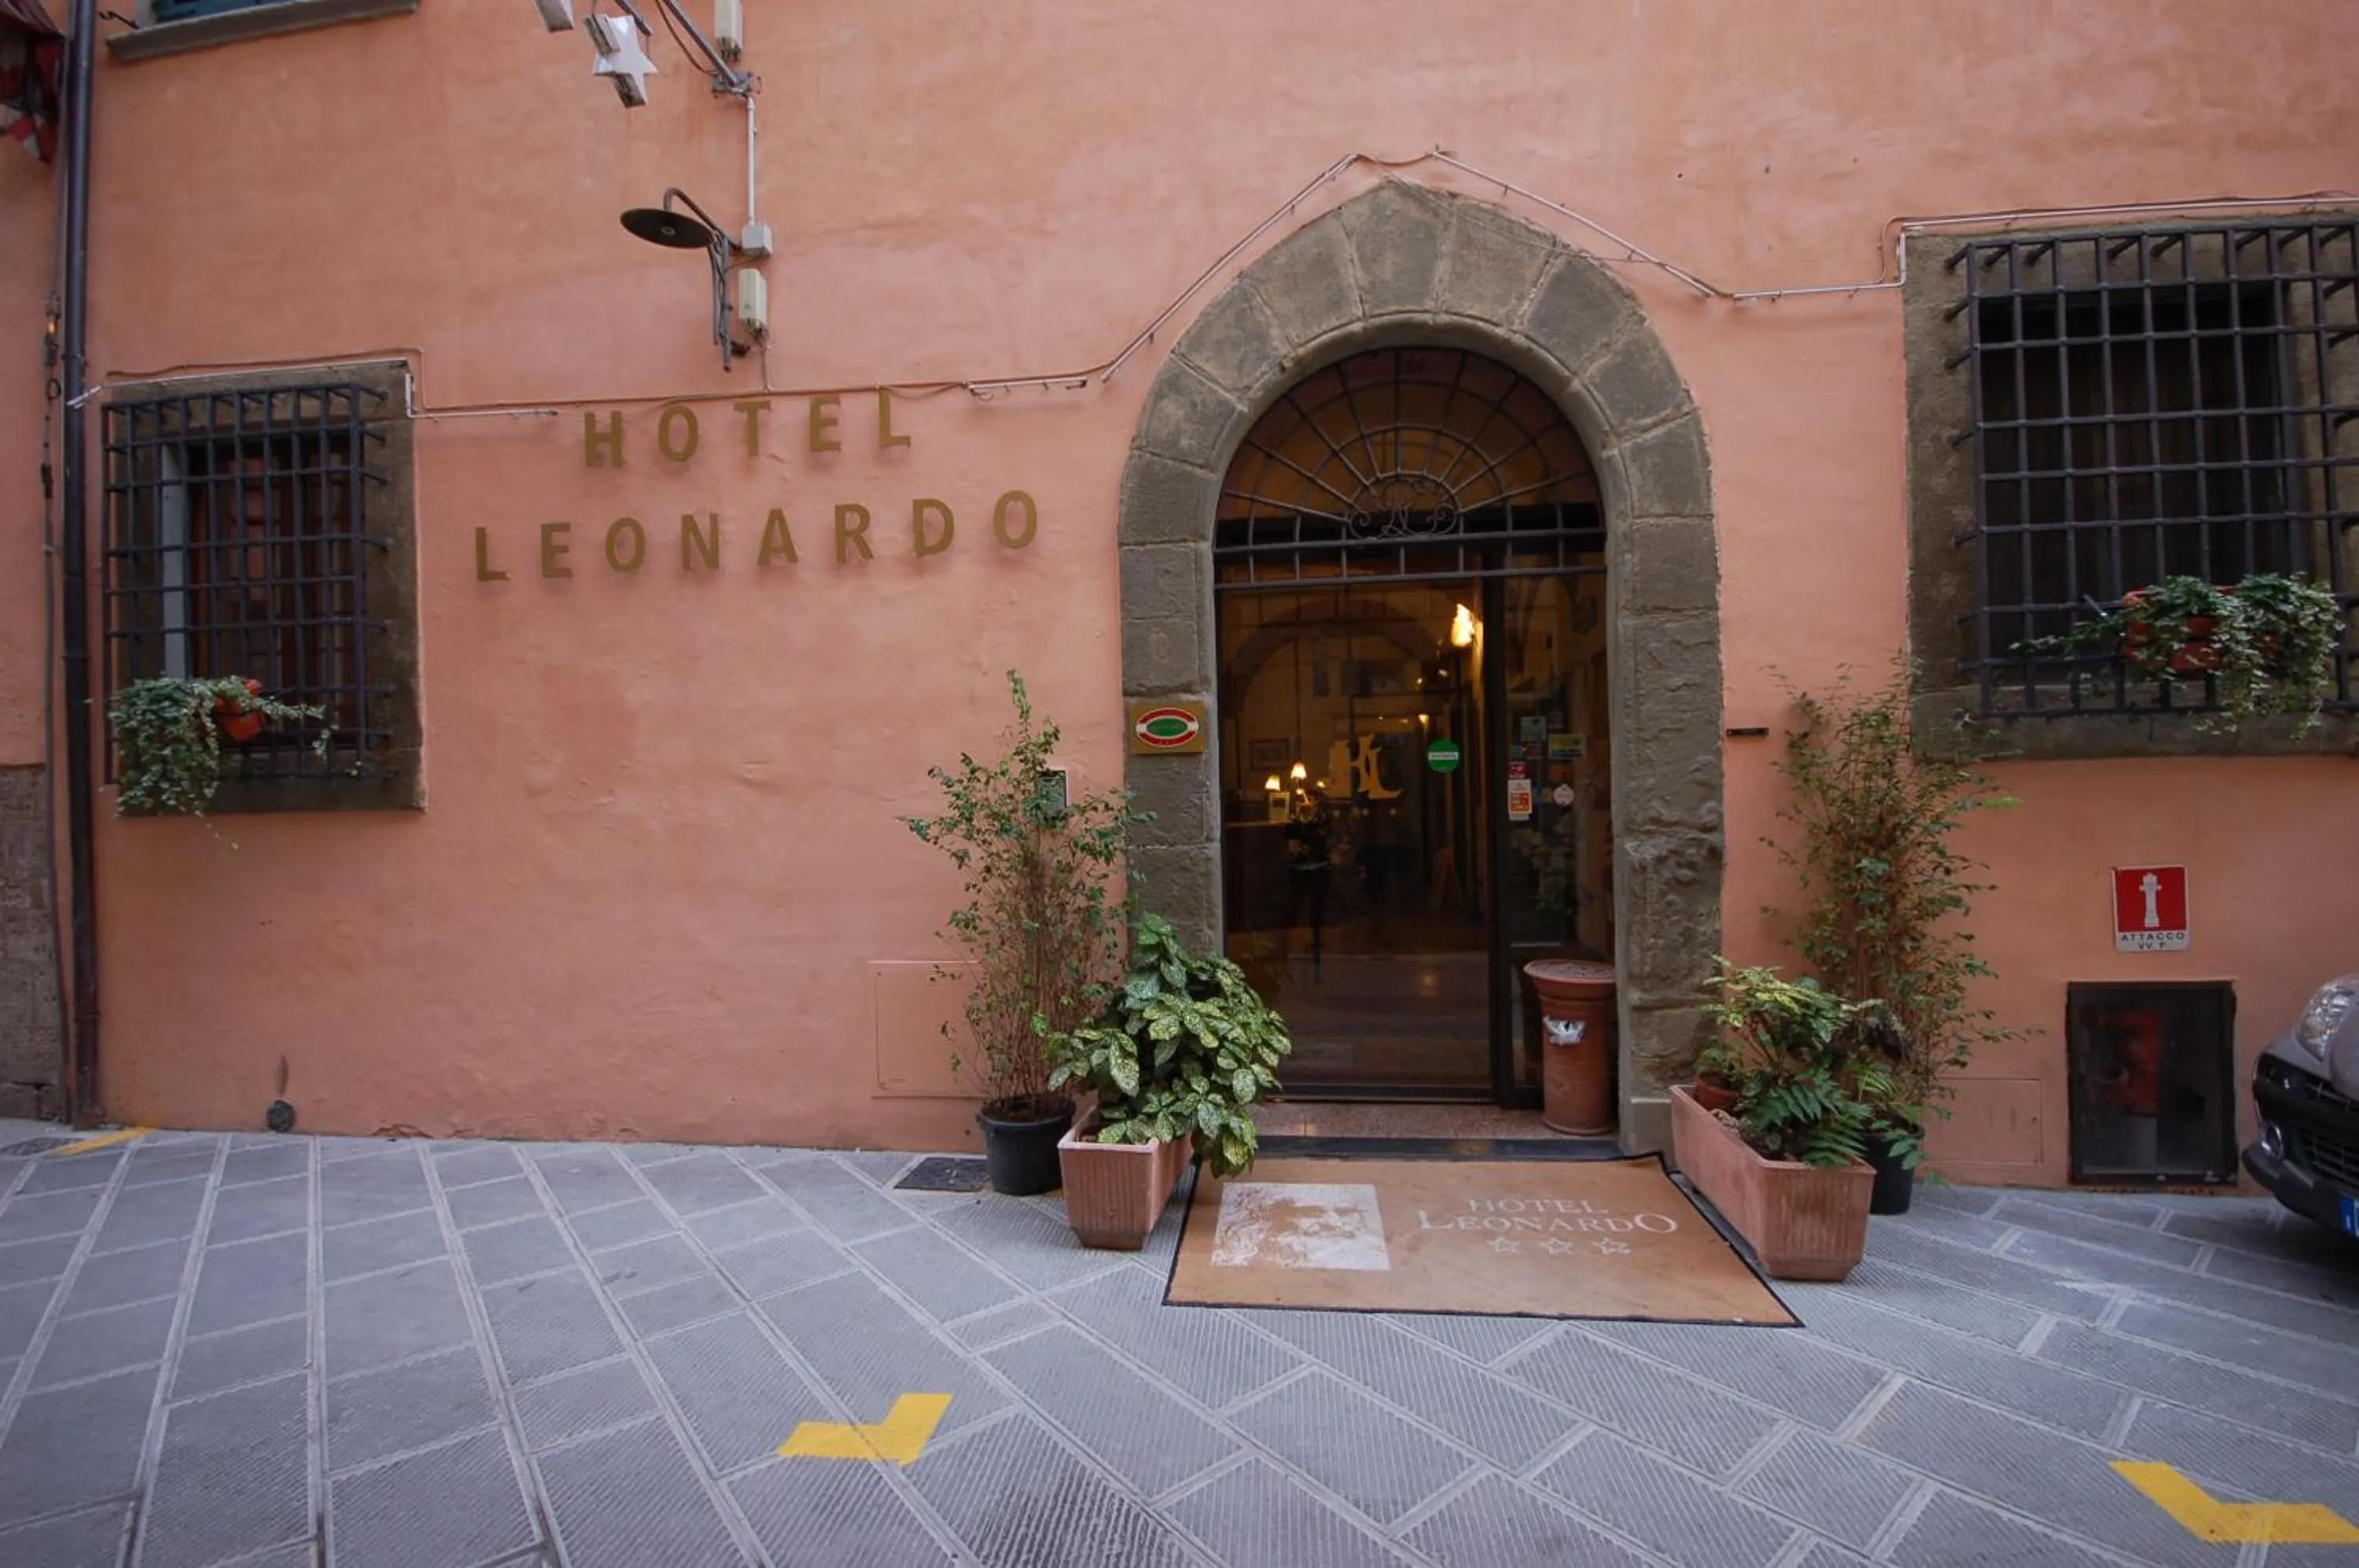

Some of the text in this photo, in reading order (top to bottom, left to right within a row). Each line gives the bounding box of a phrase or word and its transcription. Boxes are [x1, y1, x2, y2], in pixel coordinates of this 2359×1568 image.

[583, 390, 911, 467] HOTEL
[474, 489, 1039, 582] LEONARDO
[2121, 932, 2185, 941] ATTACCO
[1468, 1198, 1609, 1214] HOTEL
[1417, 1209, 1678, 1234] LEONARDO
